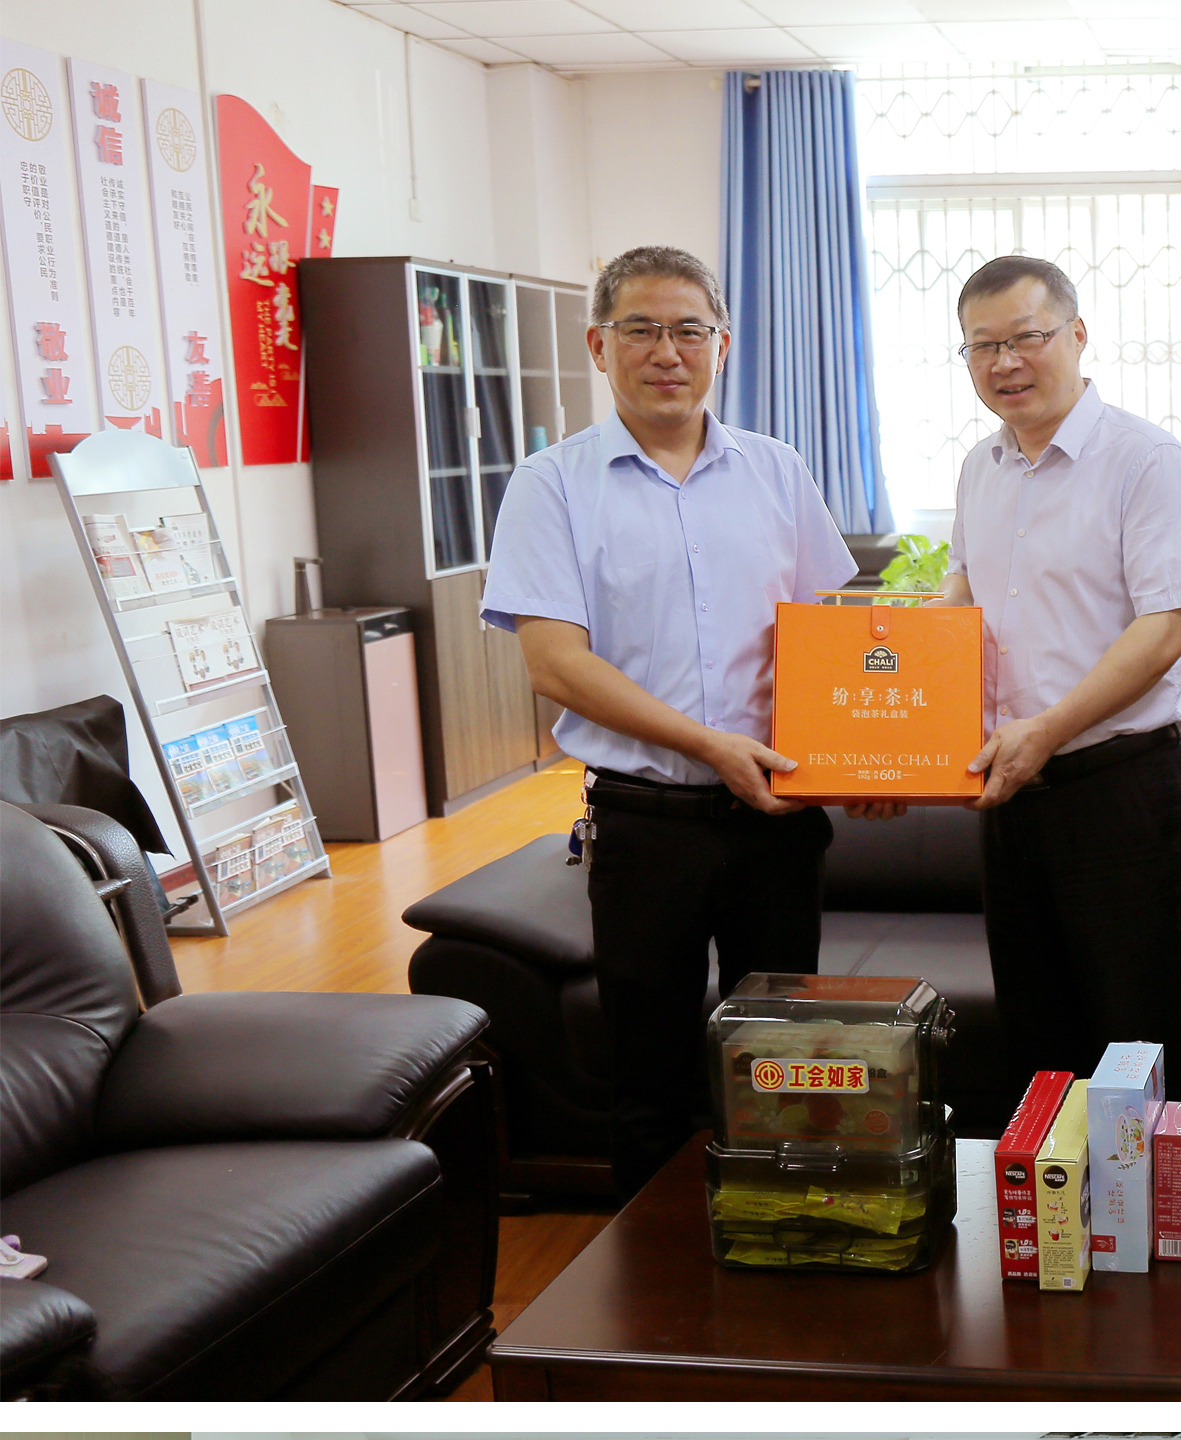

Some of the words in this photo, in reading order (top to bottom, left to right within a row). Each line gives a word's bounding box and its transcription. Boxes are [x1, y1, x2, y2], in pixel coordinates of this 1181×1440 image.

[90, 81, 124, 167] 诚信
[34, 322, 73, 406] 敬业
[183, 330, 212, 408] 友善
[868, 658, 894, 666] CHALI
[852, 709, 909, 719] 袋泡茶礼盒装
[808, 753, 837, 765] FEN
[843, 753, 892, 766] XIANG
[898, 754, 931, 766] CHA
[937, 754, 949, 766] LI
[880, 769, 896, 781] 60
[788, 1063, 867, 1090] 工会如家
